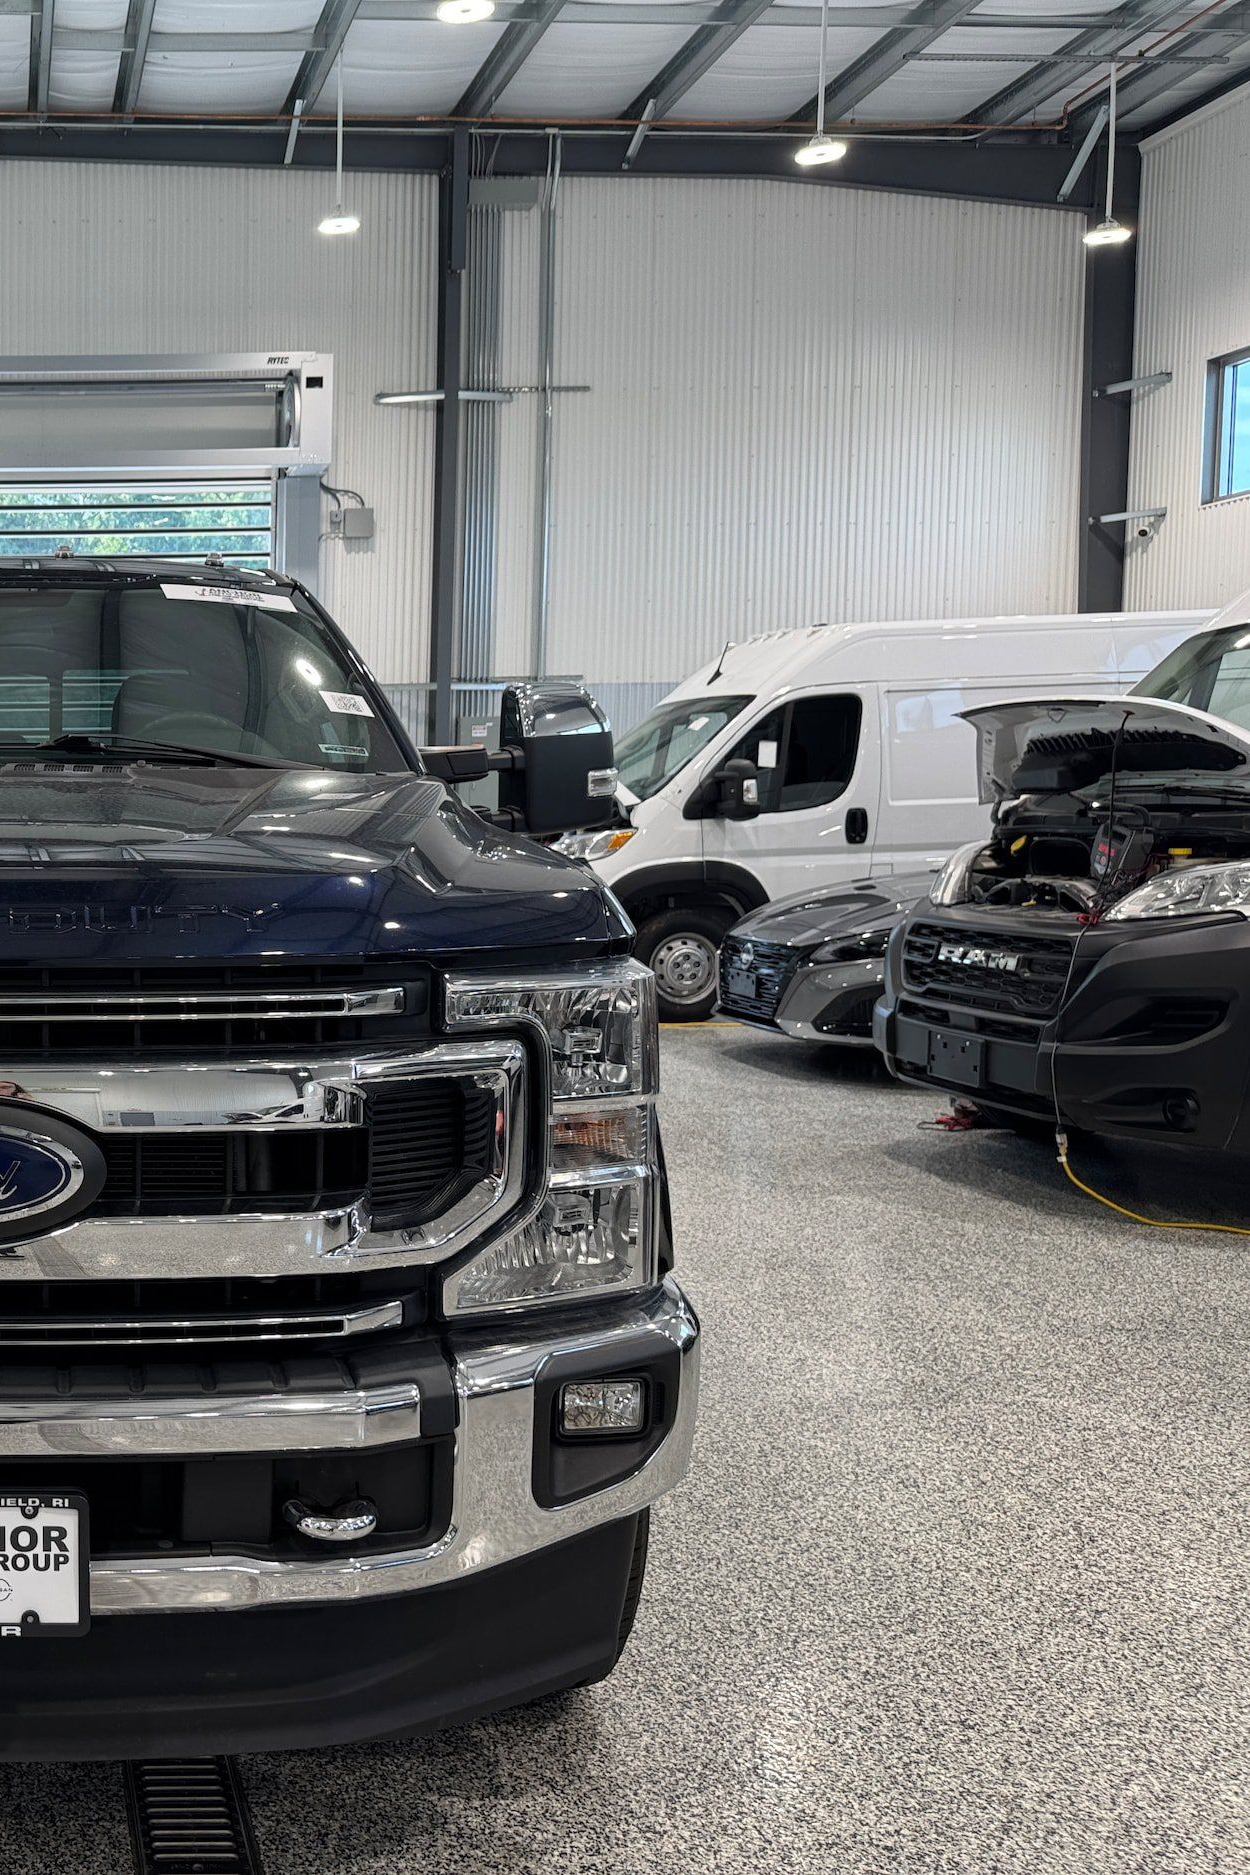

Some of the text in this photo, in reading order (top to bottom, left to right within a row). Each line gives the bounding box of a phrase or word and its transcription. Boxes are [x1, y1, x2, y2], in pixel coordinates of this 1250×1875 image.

[8, 901, 280, 934] DUTY
[937, 945, 1021, 972] RAM
[52, 1498, 69, 1507] RI
